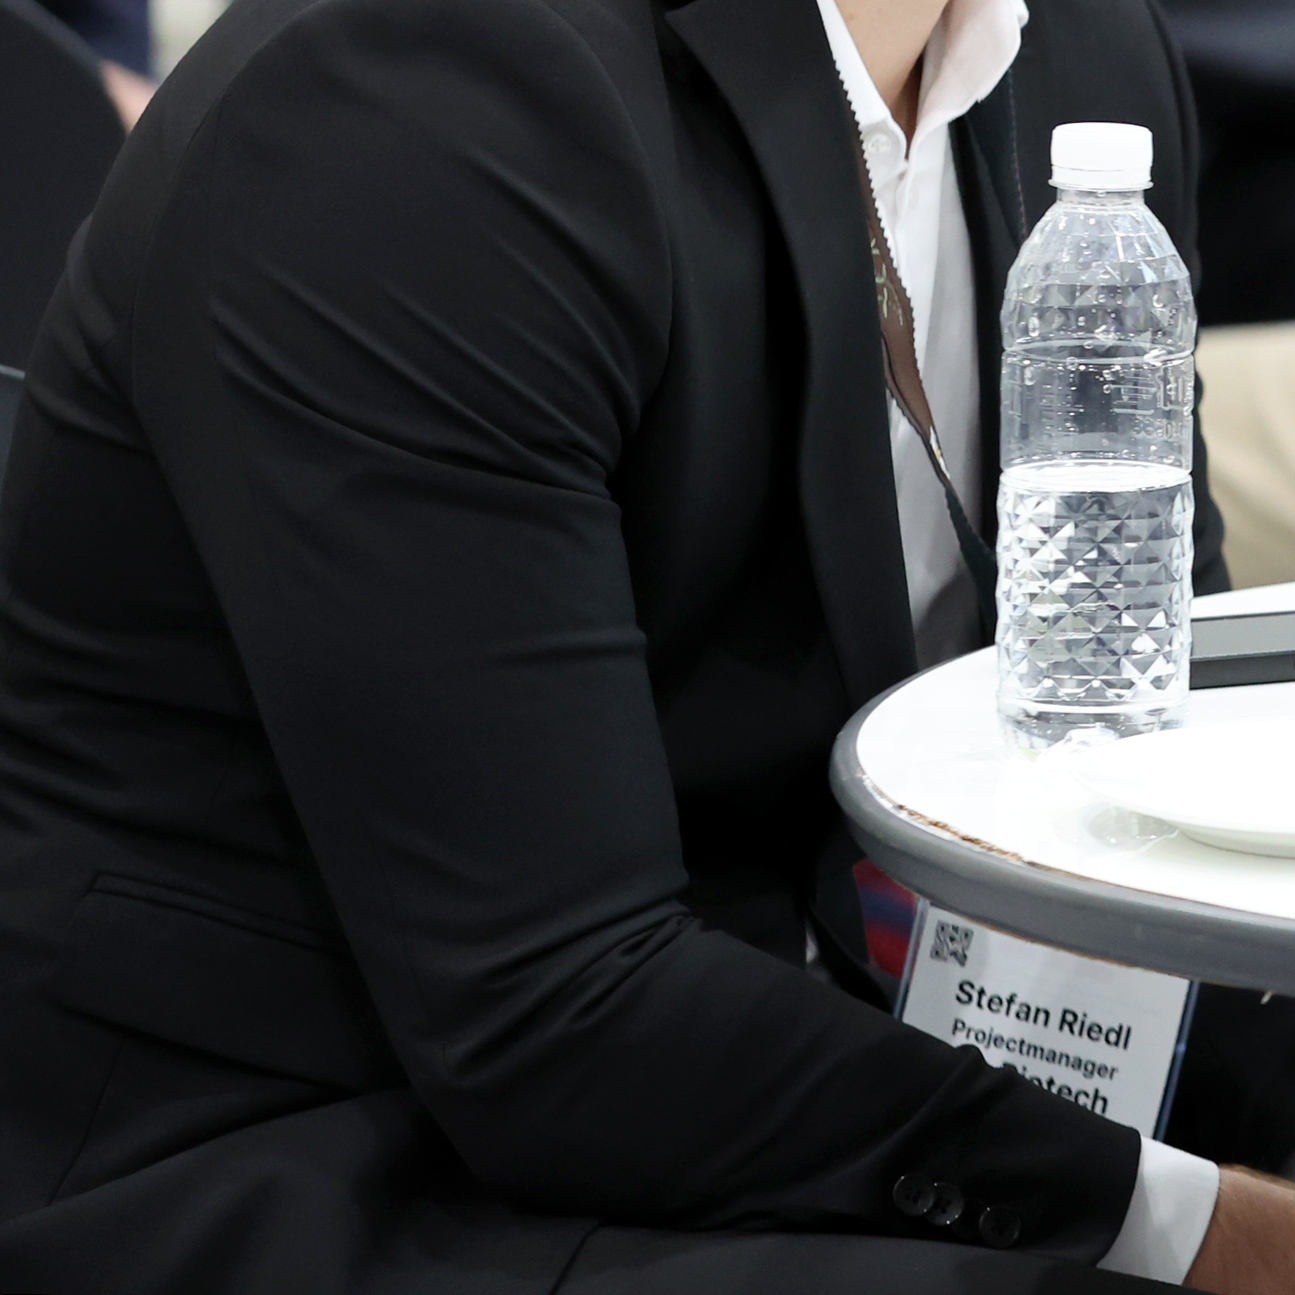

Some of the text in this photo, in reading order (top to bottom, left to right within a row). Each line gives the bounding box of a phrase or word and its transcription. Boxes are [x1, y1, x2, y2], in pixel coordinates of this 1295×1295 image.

[955, 980, 1132, 1051] Stefan Riedl
[952, 1018, 1119, 1081] Projectmanager
[1002, 1061, 1109, 1115] tech
